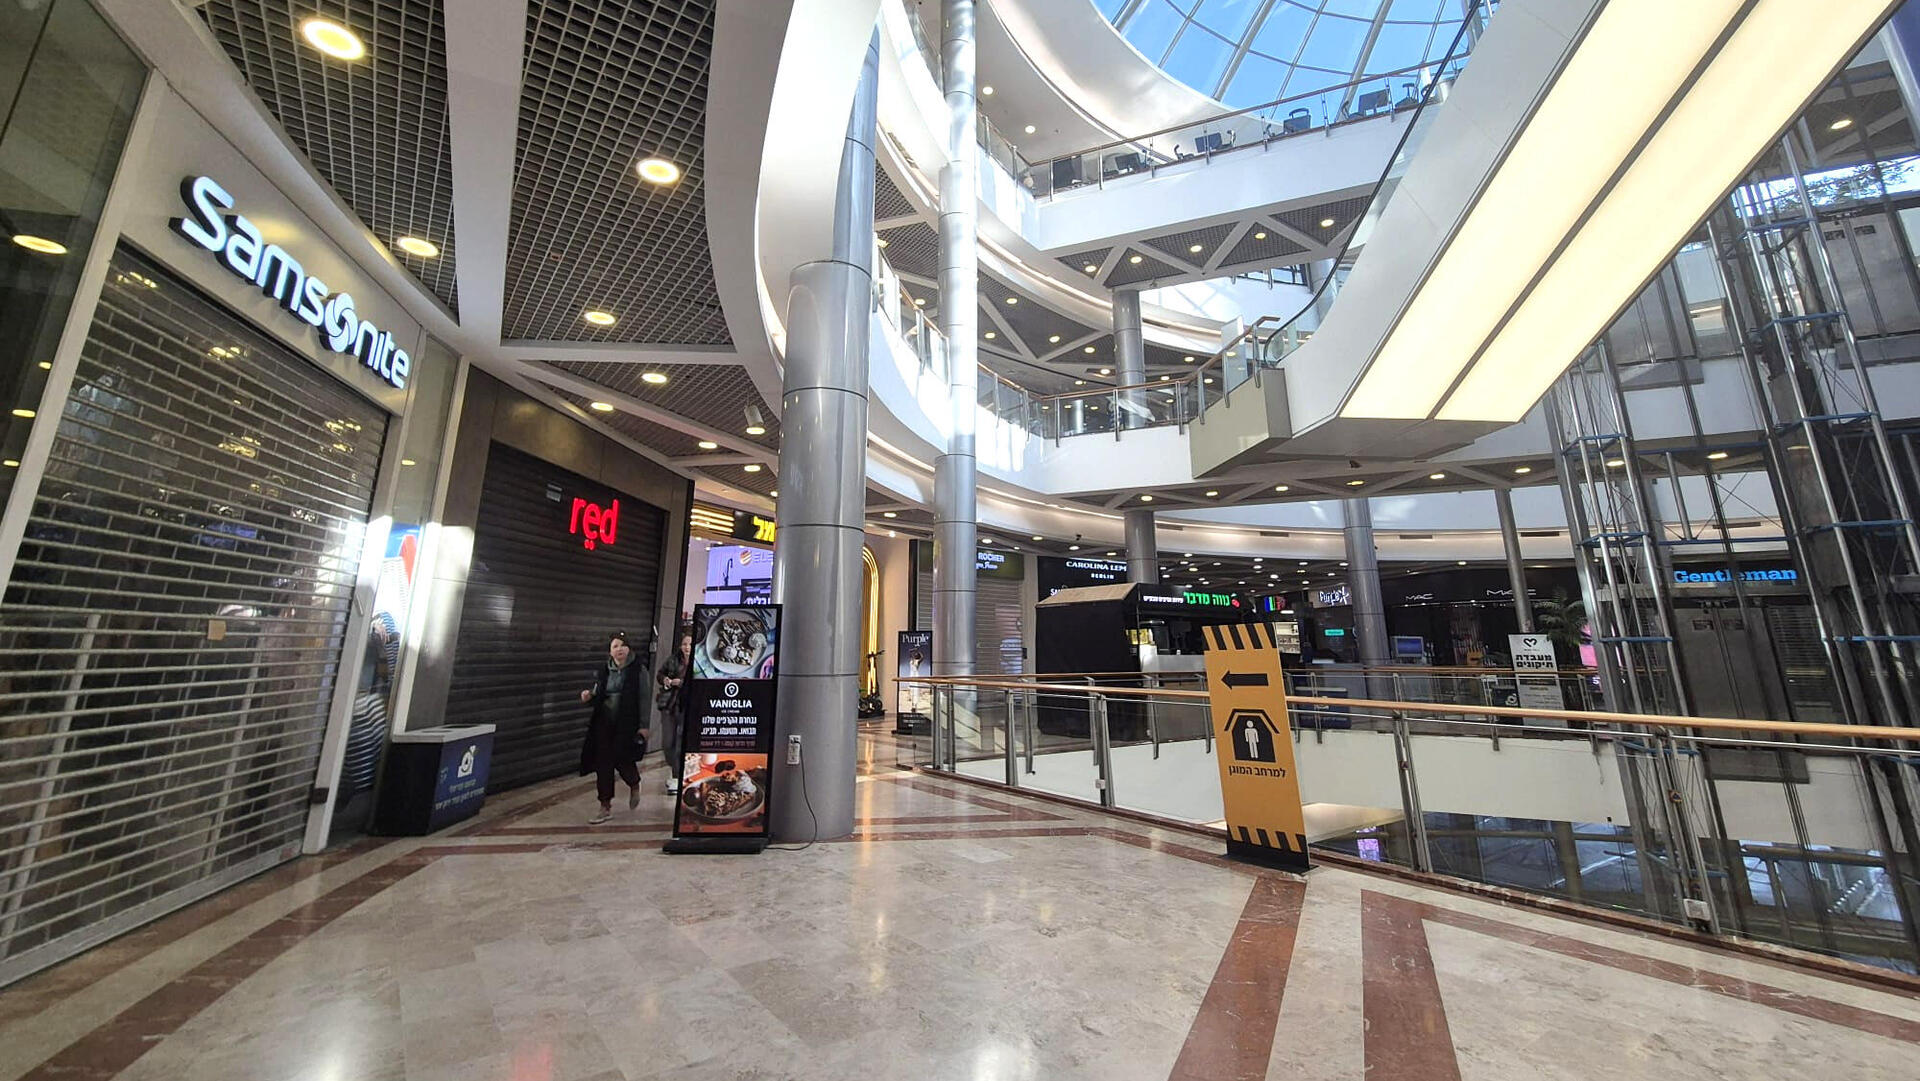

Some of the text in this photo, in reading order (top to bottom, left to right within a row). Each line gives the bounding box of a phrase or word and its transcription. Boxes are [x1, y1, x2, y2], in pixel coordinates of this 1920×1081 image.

[175, 175, 410, 389] Samsonite
[1066, 561, 1109, 571] CAROLINA
[1674, 568, 1797, 583] Gentleman
[1183, 591, 1210, 605] מדבר
[1212, 594, 1230, 606] נווה
[902, 633, 929, 647] Purple
[1516, 661, 1554, 669] תיקונים
[709, 699, 753, 708] VANIGLIA
[702, 716, 716, 724] שלנו
[739, 716, 757, 724] נבחרת
[1229, 765, 1286, 778] למרחב המוגן
